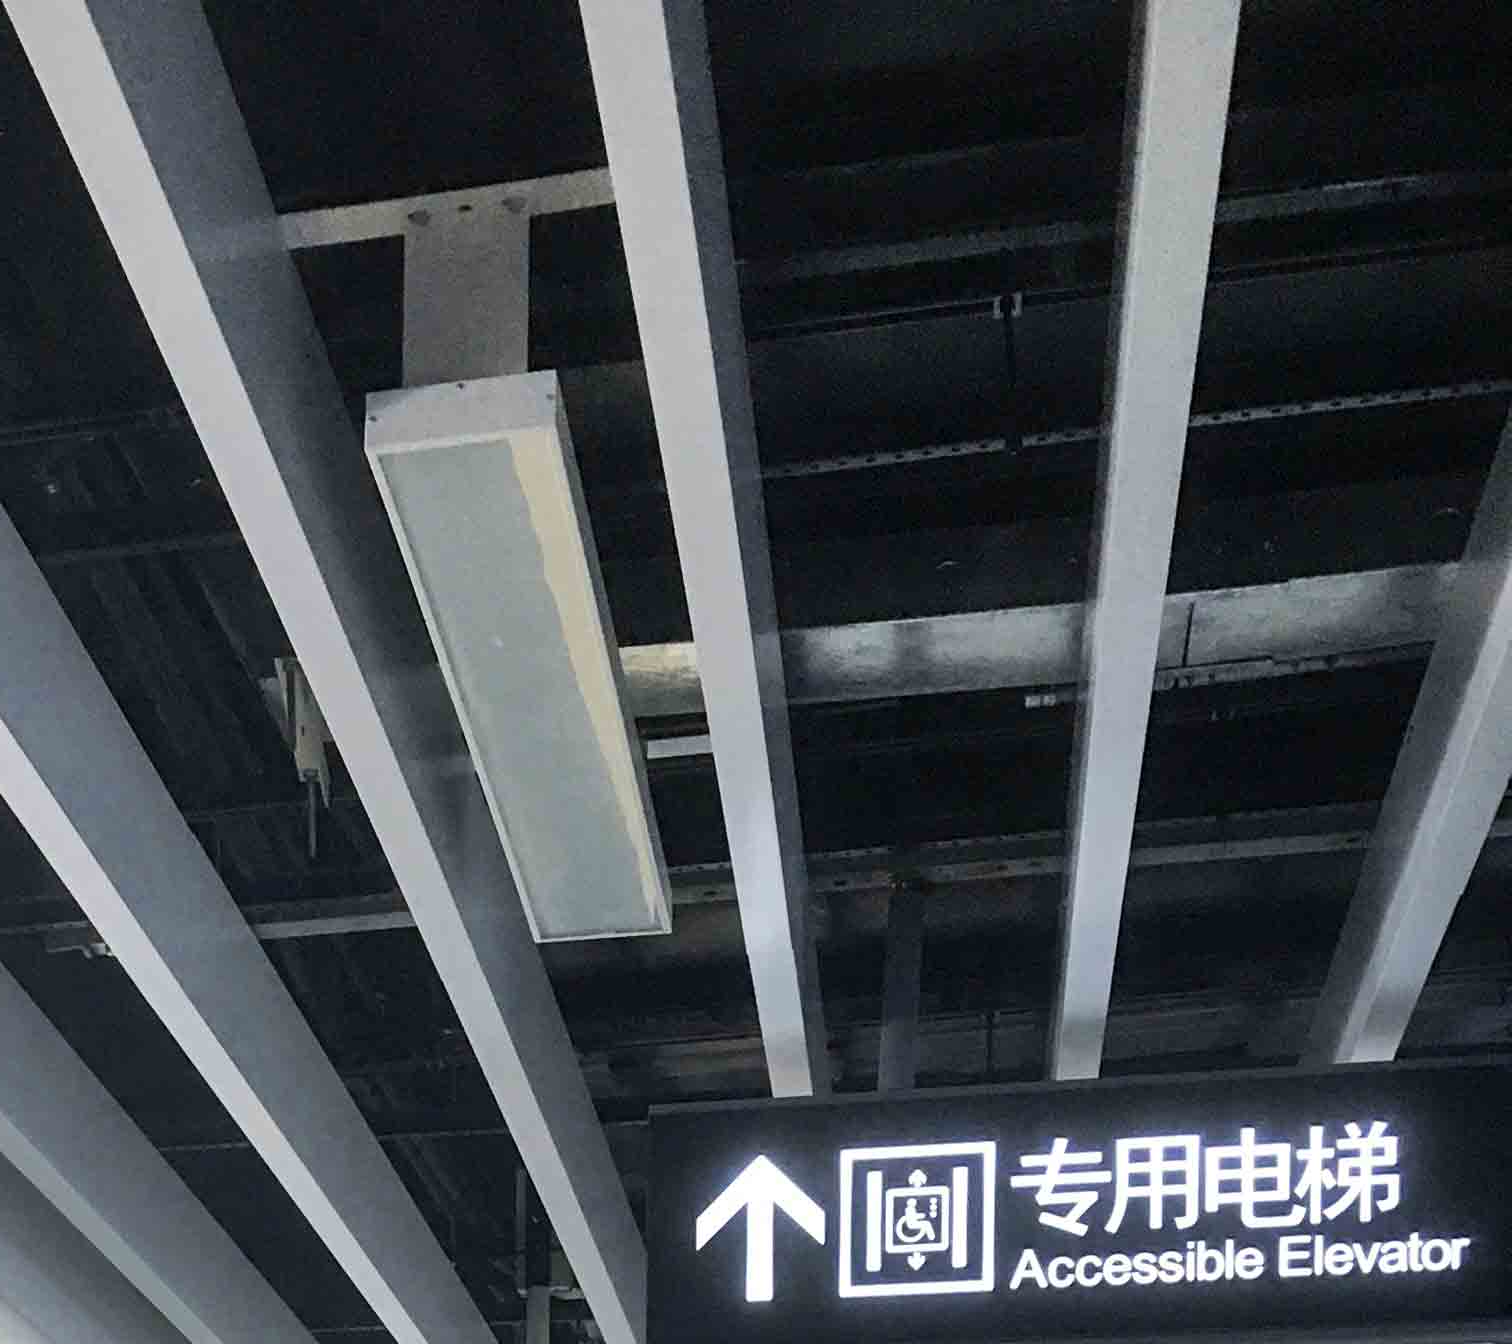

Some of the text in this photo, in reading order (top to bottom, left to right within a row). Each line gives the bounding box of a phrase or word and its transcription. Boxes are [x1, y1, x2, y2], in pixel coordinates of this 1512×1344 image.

[1009, 1120, 1399, 1237] 专用电梯
[1010, 1232, 1471, 1290] Accessible Elevator
